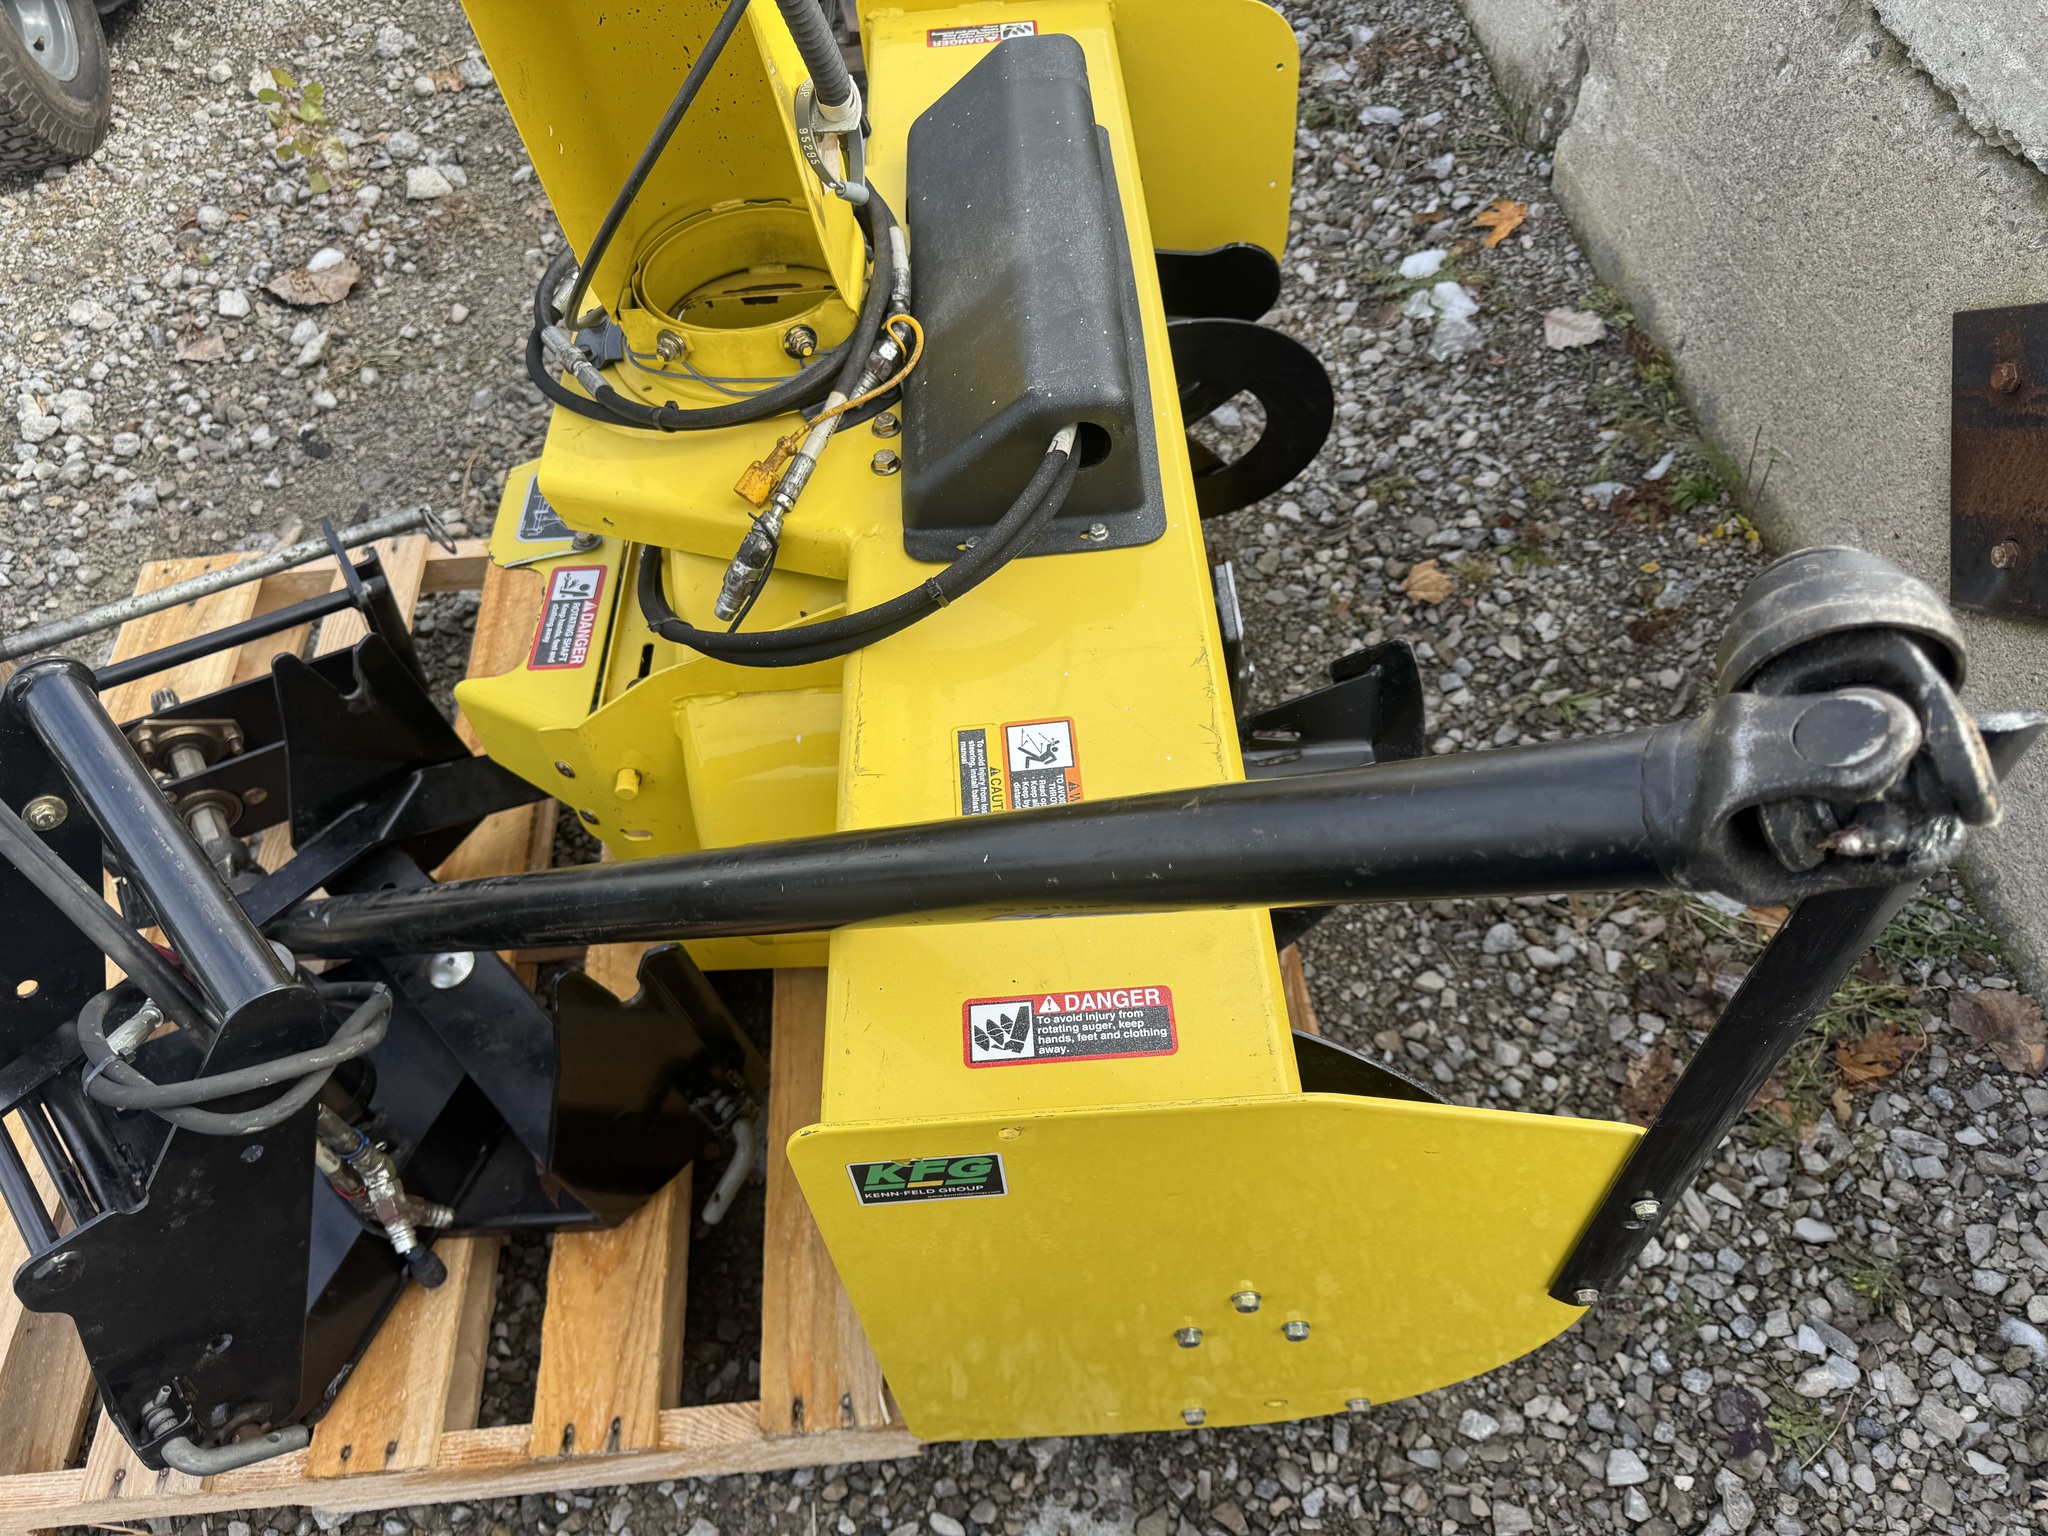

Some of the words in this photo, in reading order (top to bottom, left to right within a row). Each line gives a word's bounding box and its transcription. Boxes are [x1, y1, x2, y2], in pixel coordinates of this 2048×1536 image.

[932, 37, 984, 46] DANGER
[546, 604, 559, 628] clothing
[559, 603, 570, 618] Keep
[554, 618, 566, 638] hands,
[565, 602, 581, 637] ROTATING
[542, 628, 552, 643] away
[570, 613, 595, 664] DANGER
[551, 638, 560, 651] feet
[559, 638, 572, 662] SHAFT
[548, 651, 556, 663] and
[977, 739, 984, 748] To
[968, 740, 977, 768] steering,
[970, 769, 978, 789] install
[978, 767, 986, 785] injury
[1056, 774, 1064, 784] TO
[1030, 780, 1038, 798] Keep
[1039, 780, 1048, 797] Read
[1064, 988, 1161, 1011] DANGER
[1037, 1016, 1052, 1025] To
[1053, 1013, 1083, 1024] avoid
[1086, 1011, 1116, 1023] injury
[1119, 1009, 1144, 1019] from
[1038, 1023, 1080, 1036] rotating
[1082, 1022, 1116, 1033] auger,
[1118, 1020, 1144, 1031] keep
[1038, 1034, 1074, 1044] hands,
[1077, 1032, 1098, 1042] feet
[1100, 1030, 1120, 1040] and
[1123, 1027, 1168, 1039] clothing
[1038, 1045, 1070, 1055] away.
[865, 1157, 994, 1185] KFG
[864, 1188, 935, 1199] KENN-FELD
[939, 1185, 985, 1194] GROUP
